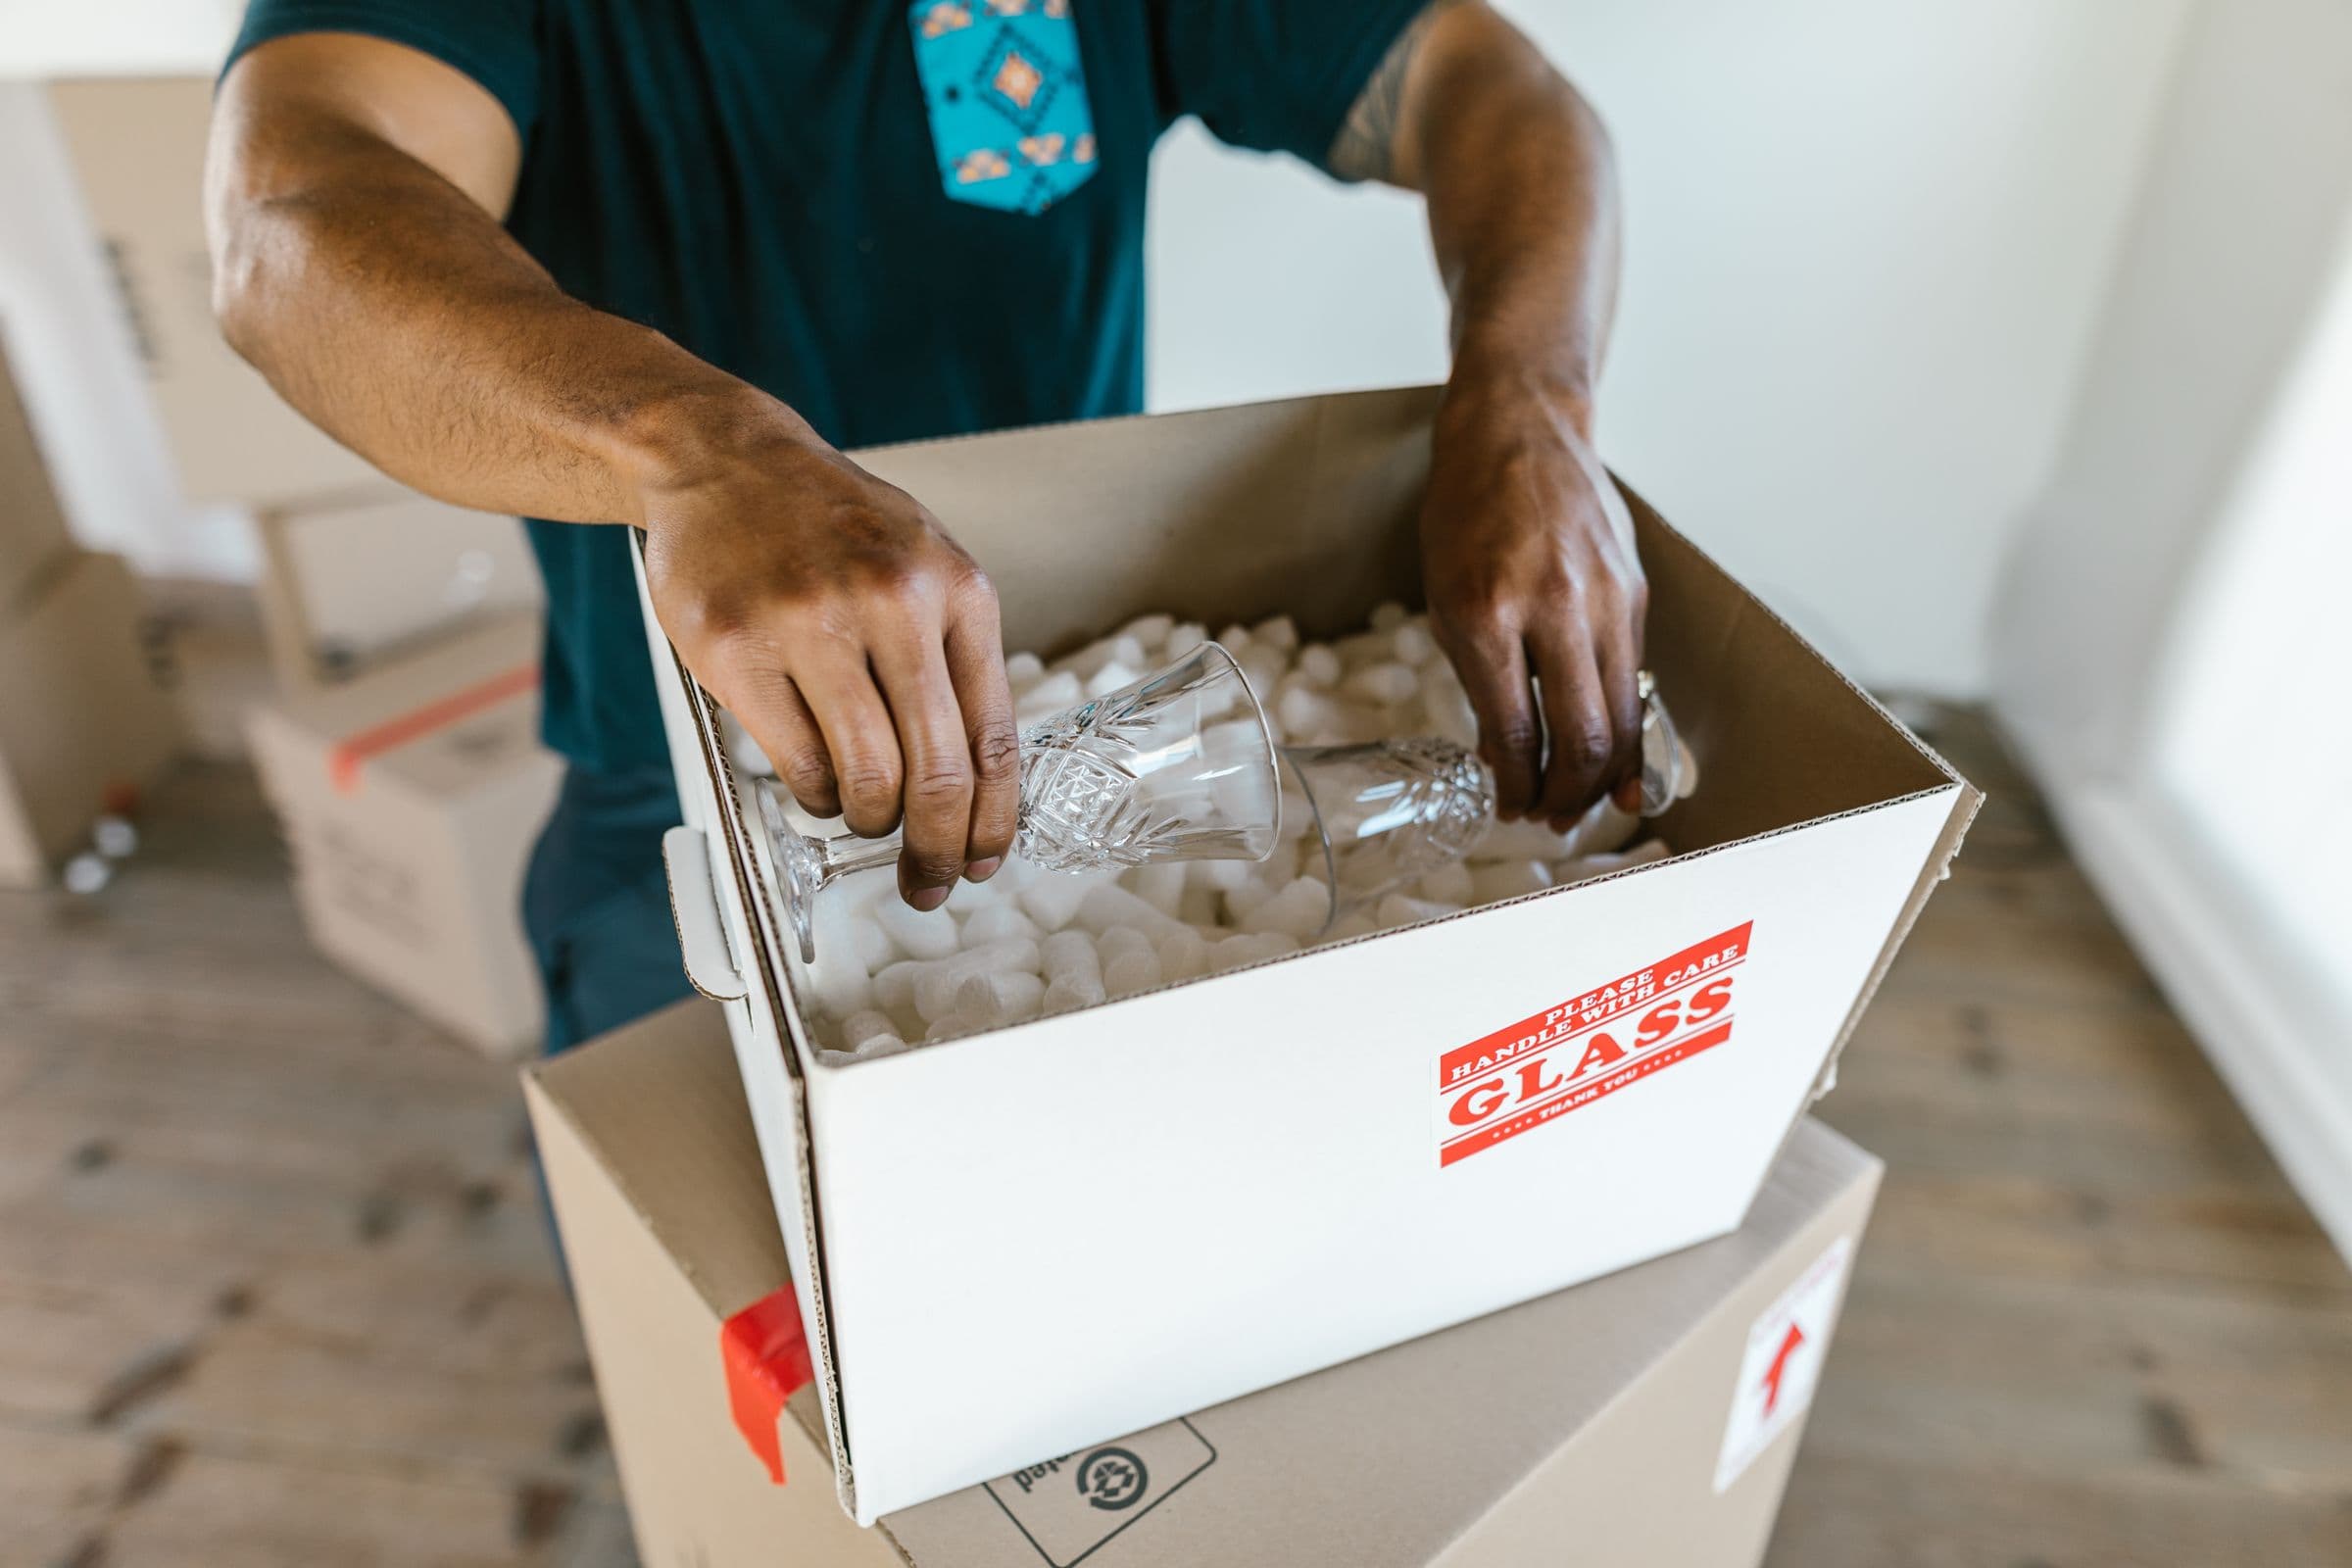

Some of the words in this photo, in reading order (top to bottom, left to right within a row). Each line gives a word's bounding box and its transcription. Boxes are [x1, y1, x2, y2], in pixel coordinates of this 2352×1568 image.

[1450, 1018, 1573, 1082] HANDLE
[1580, 981, 1656, 1023] WITH
[1663, 944, 1740, 987] CARE
[1544, 968, 1654, 1027] PLEASE
[1447, 976, 1734, 1127] GLASS
[1539, 1087, 1600, 1120] THANK
[1603, 1067, 1639, 1092] YOU
